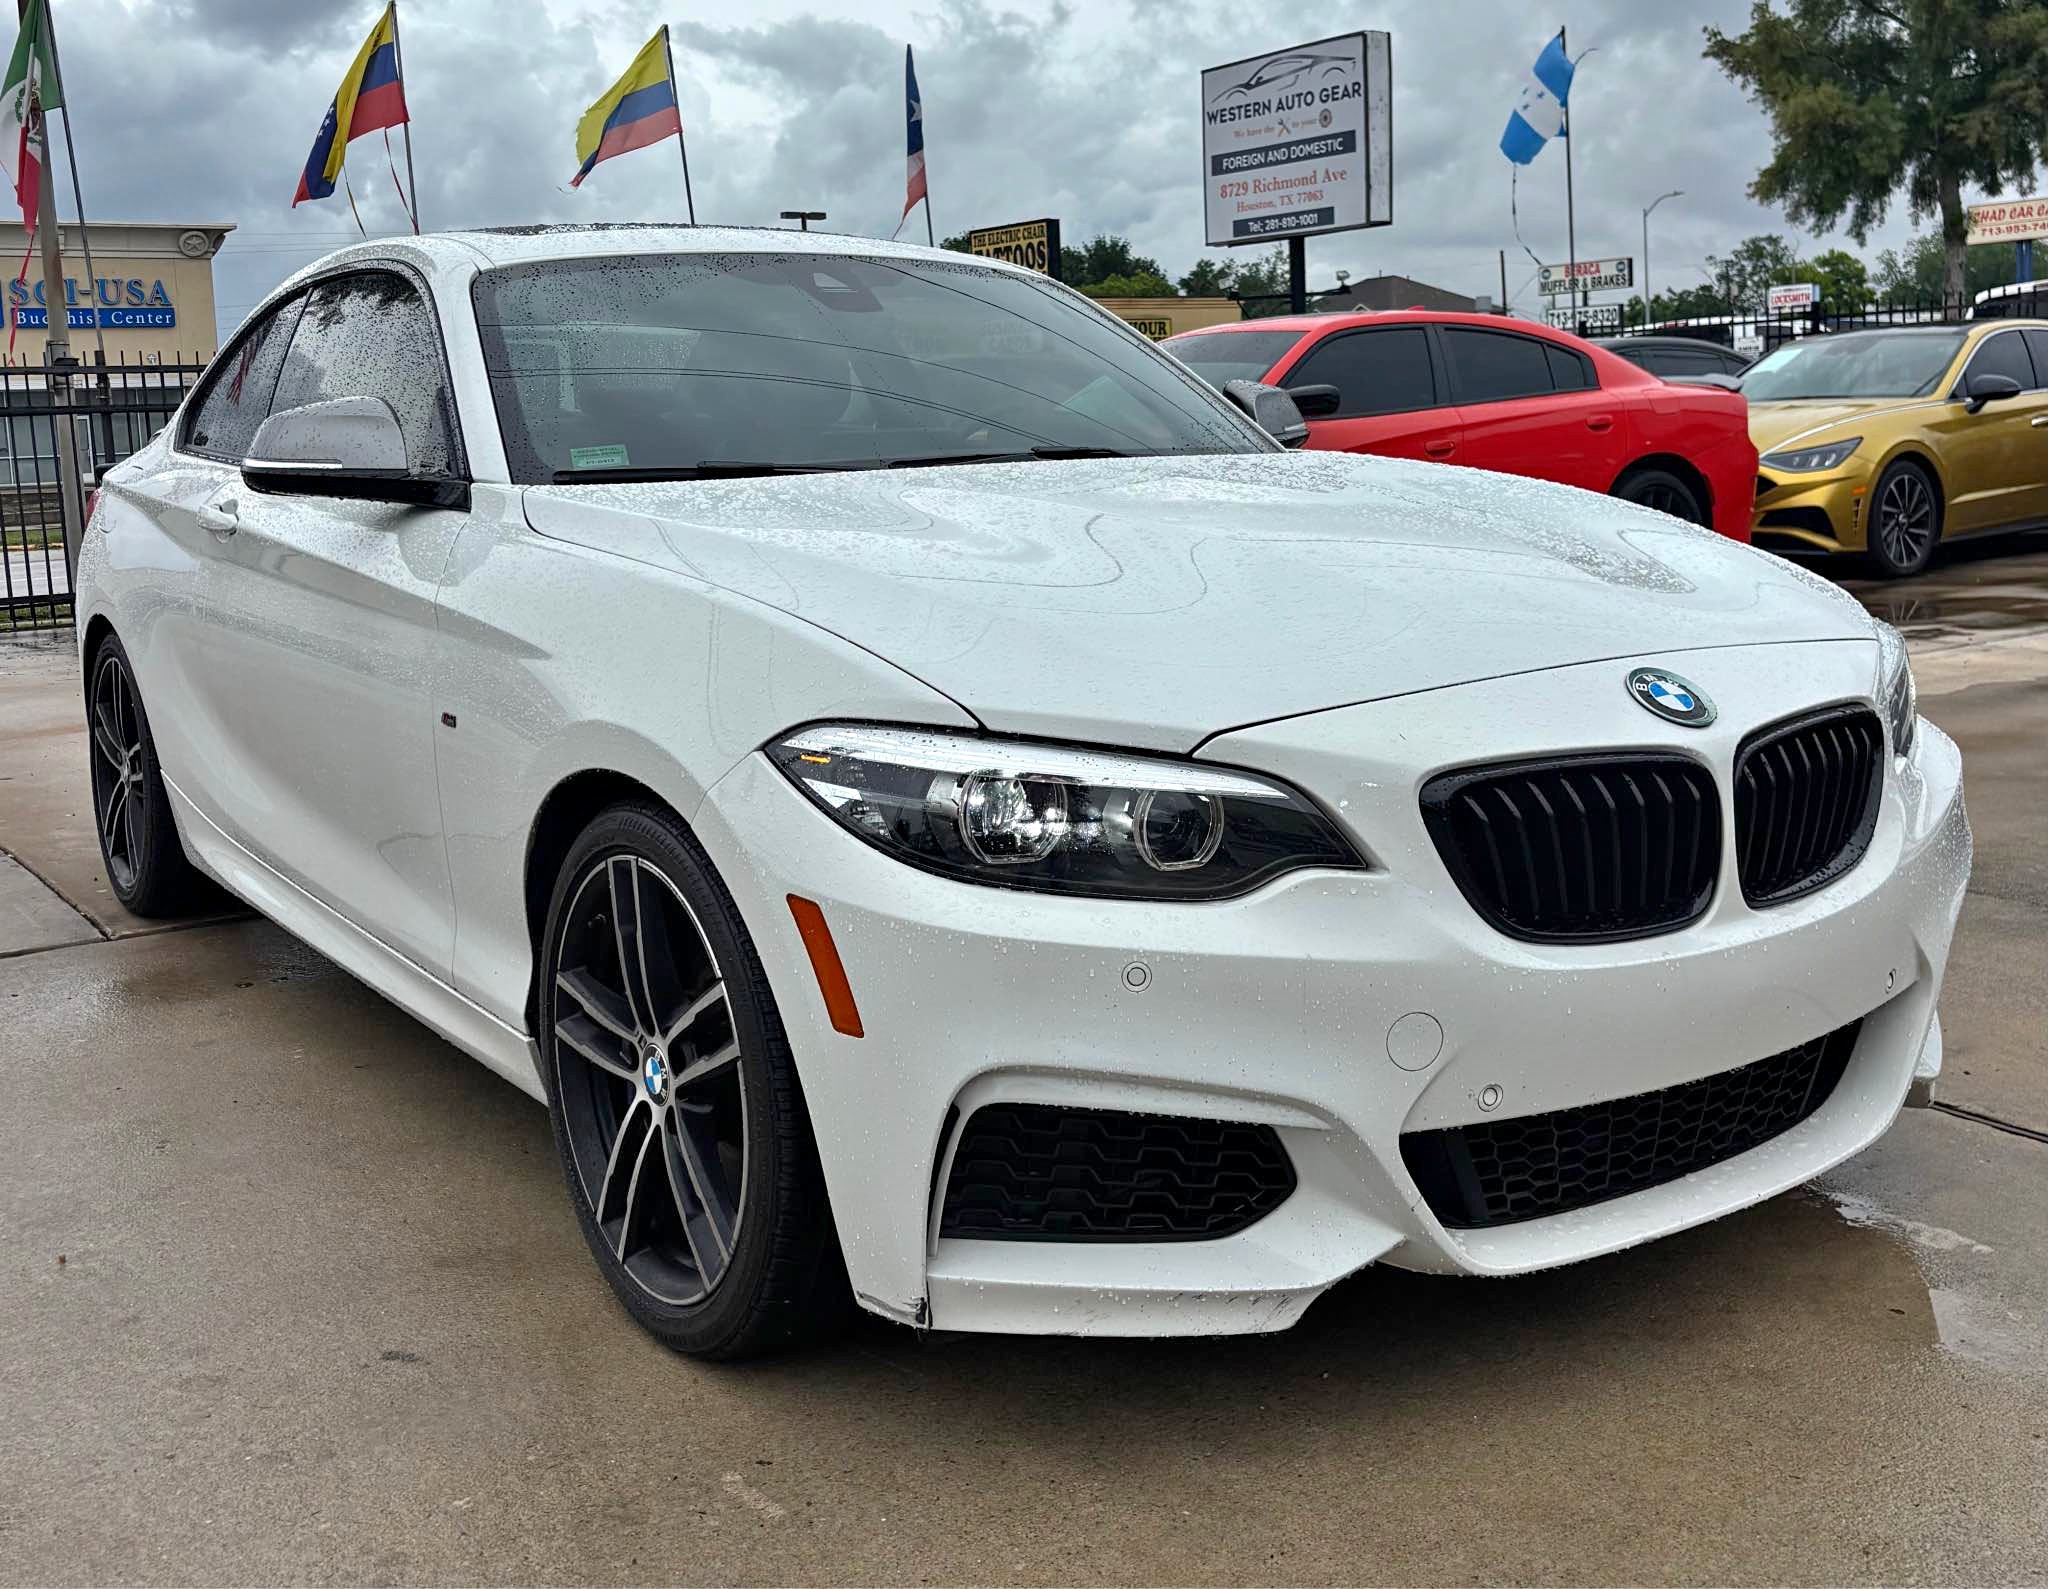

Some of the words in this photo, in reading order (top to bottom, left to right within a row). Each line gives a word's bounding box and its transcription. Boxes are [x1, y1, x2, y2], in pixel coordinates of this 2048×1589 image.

[1206, 99, 1271, 126] WESTERN
[1276, 90, 1314, 112] AUTO
[1319, 82, 1362, 103] GEAR
[1222, 152, 1266, 170] FOREIGN
[1267, 148, 1288, 162] AND
[1290, 138, 1343, 158] DOMESTIC
[1220, 182, 1248, 199] 8729
[1252, 170, 1317, 194] Richmond
[1322, 168, 1347, 183] Ave
[1280, 195, 1295, 206] TX
[1265, 214, 1318, 230] 281-810-1001
[1973, 208, 2006, 223] HAD
[2010, 205, 2033, 220] CAR
[974, 234, 986, 248] THE
[988, 228, 1021, 246] ELECTRIC
[1022, 225, 1045, 240] CHAIR
[974, 241, 1046, 269] TTOOS
[1564, 263, 1600, 278] BRACA
[1582, 278, 1588, 290] &
[1591, 273, 1626, 288] BRAKES
[1771, 292, 1810, 305] LOCKSMITH
[17, 311, 101, 325] Buhis
[111, 311, 173, 325] Center
[1549, 308, 1617, 328] 713-75-8320
